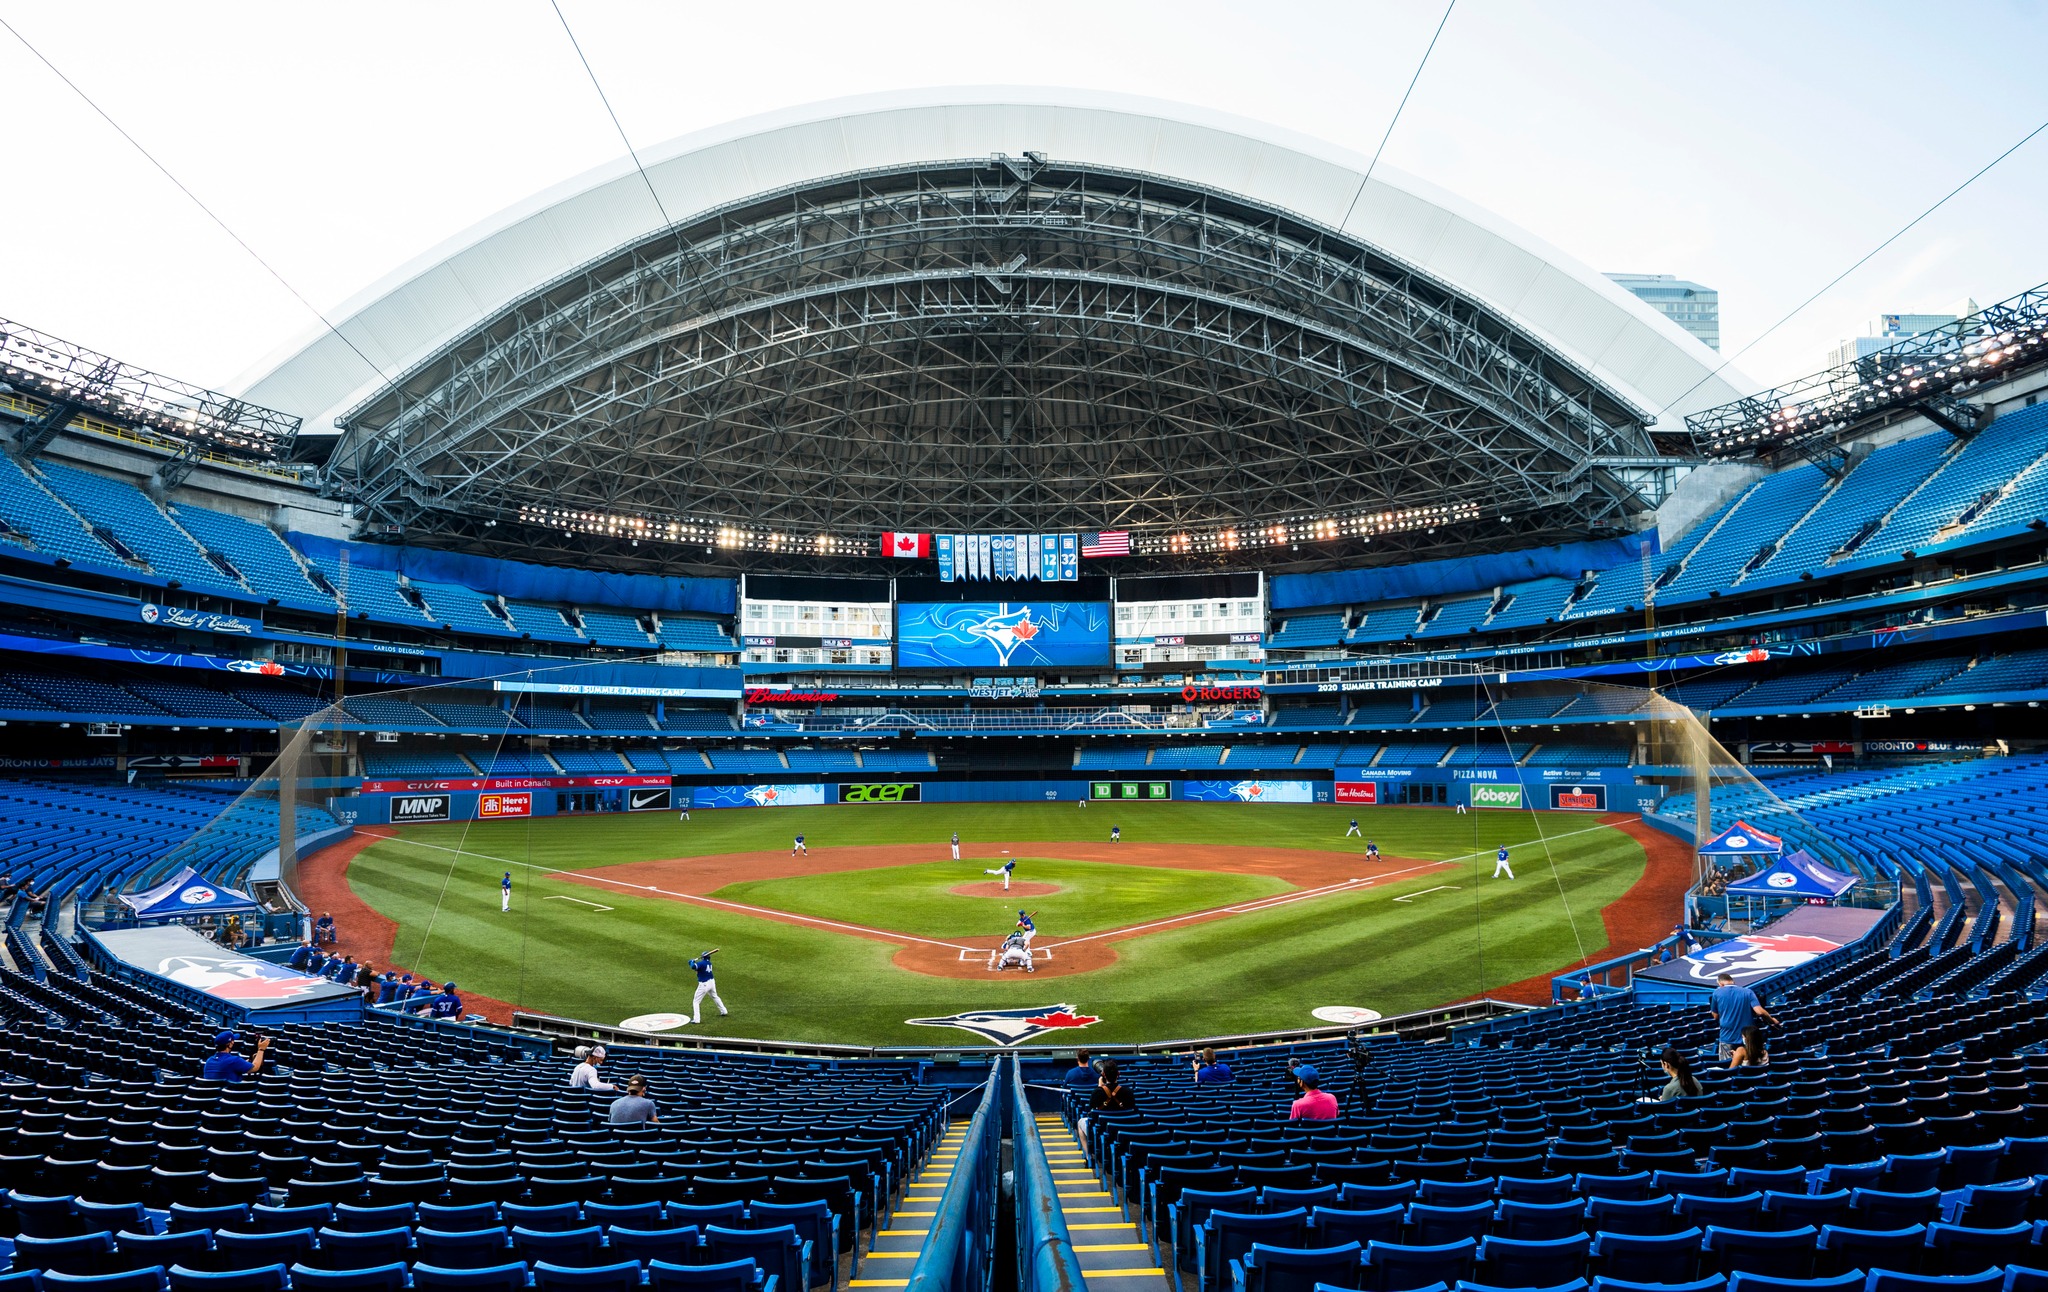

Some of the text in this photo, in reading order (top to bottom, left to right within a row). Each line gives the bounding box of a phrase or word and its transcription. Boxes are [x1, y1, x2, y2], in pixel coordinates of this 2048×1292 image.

[1043, 553, 1057, 566] 12
[1061, 553, 1077, 566] 32
[1586, 607, 1615, 618] ROBINSON
[1661, 629, 1674, 637] ROY
[1675, 626, 1706, 635] HALLADAY
[1573, 639, 1600, 648] ROBERTO
[1601, 636, 1626, 645] ALOMAR
[373, 644, 425, 656] CARLOS DELGADO
[558, 685, 686, 696] 2020 SUMMER TRAINING CAMP
[1318, 679, 1442, 692] 2020 SUMMER TRAINING CAMP
[746, 688, 838, 704] Budweiser
[968, 688, 1011, 699] WESTJET
[1201, 687, 1260, 699] ROGERS
[1865, 742, 1915, 750] TORONTO
[1453, 770, 1497, 779] PIZZA NOVA
[845, 784, 914, 801] acer
[1095, 785, 1110, 794] TD
[1123, 785, 1137, 794] TD
[1150, 785, 1165, 794] TD
[1337, 788, 1374, 797] Tim Hortons
[1473, 788, 1520, 803] Sobeys
[399, 798, 442, 814] MNP
[502, 805, 523, 813] How.
[438, 1001, 452, 1012] 37
